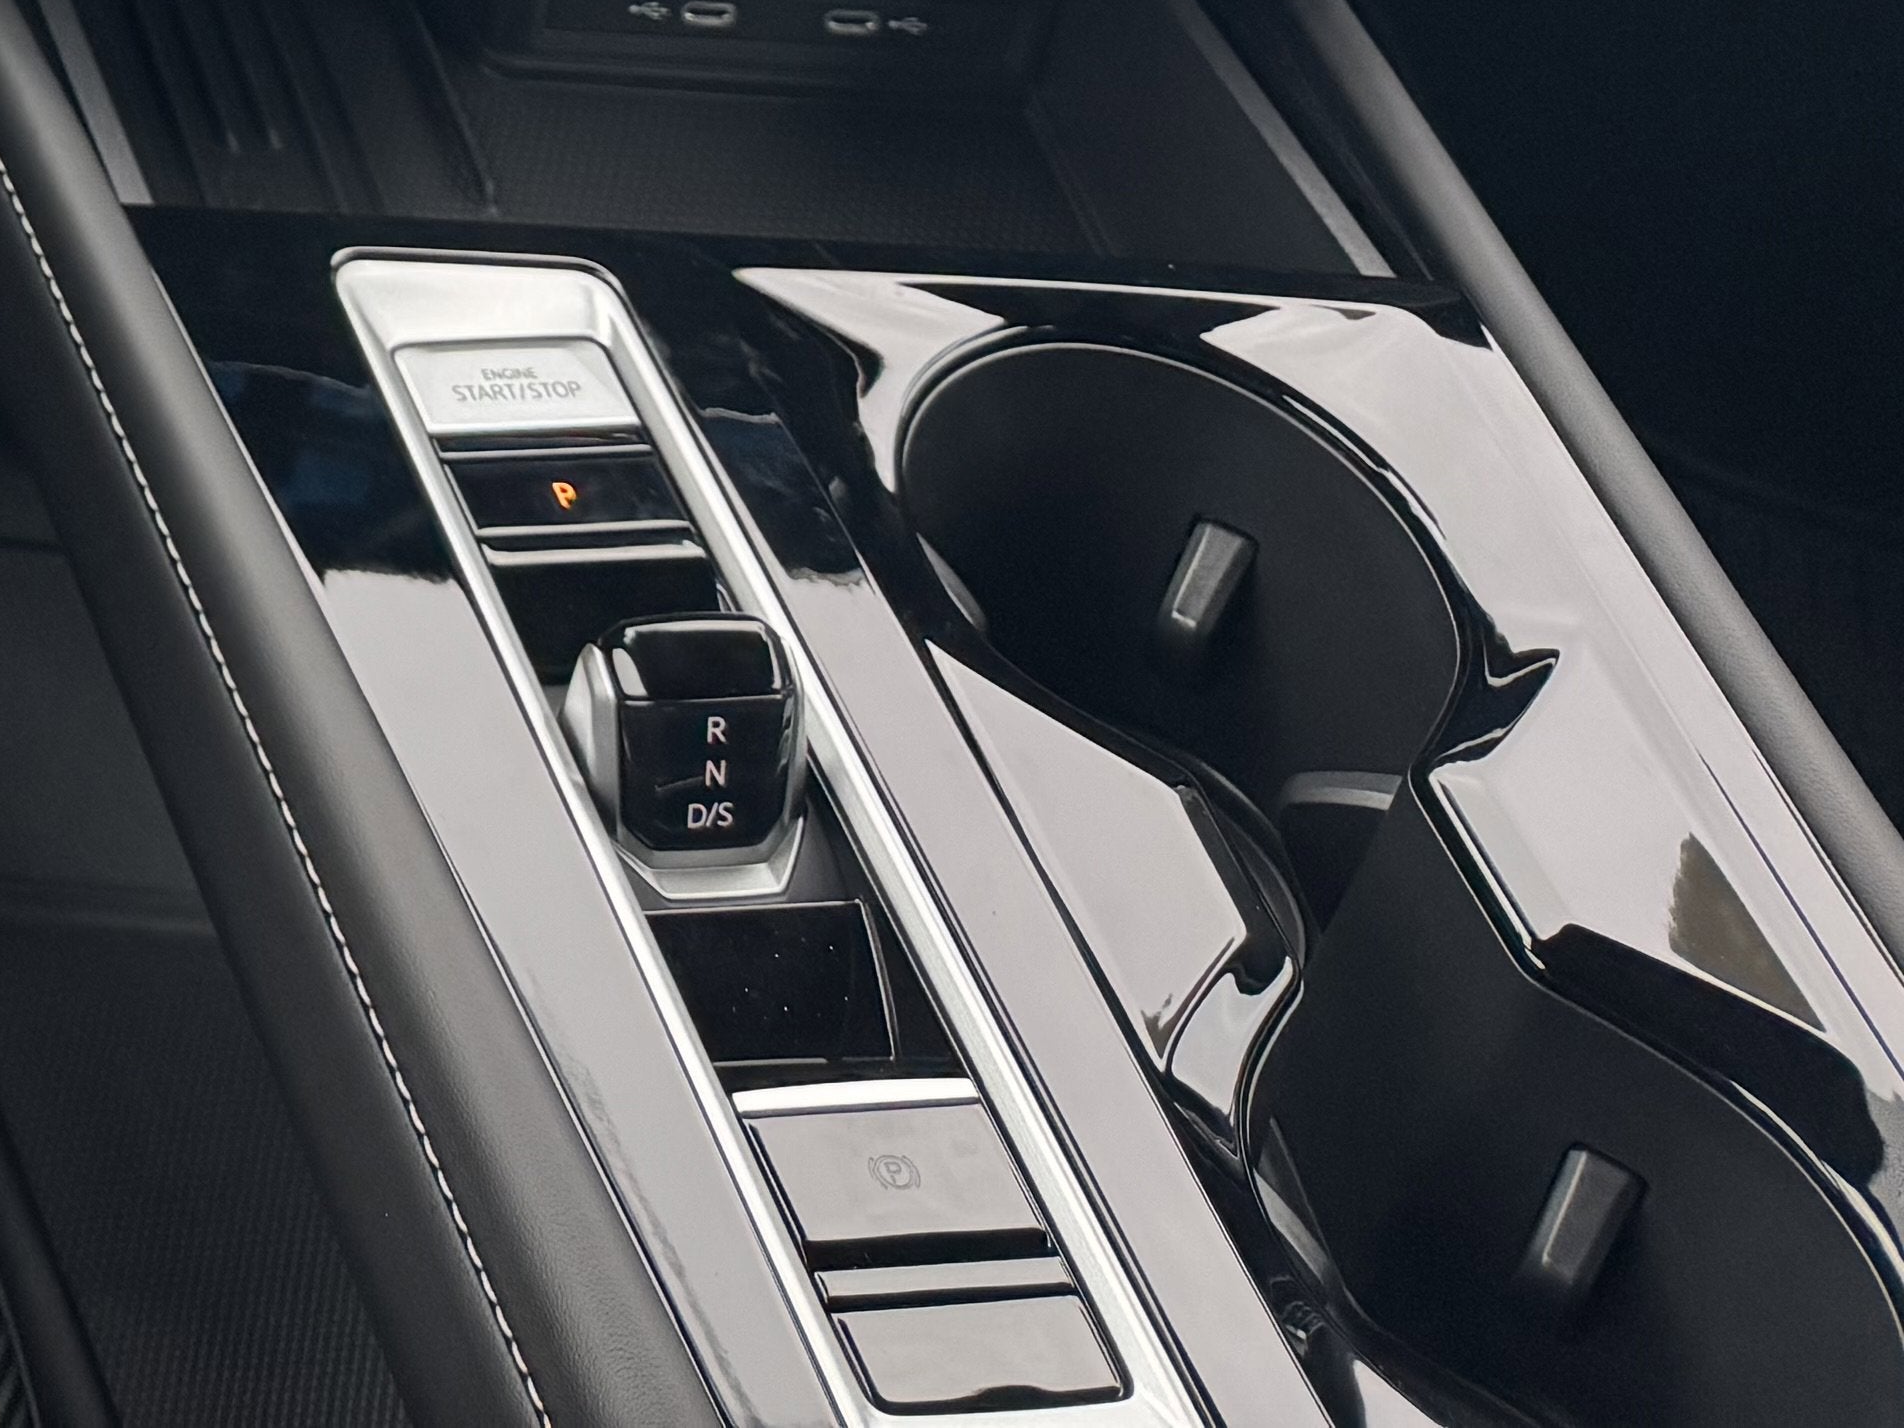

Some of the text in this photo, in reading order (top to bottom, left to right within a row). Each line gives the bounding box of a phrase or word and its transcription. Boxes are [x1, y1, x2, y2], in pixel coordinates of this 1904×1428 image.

[480, 366, 539, 382] ENGINE
[450, 380, 582, 403] START/STOP
[551, 481, 578, 511] P
[706, 716, 728, 745] R
[704, 759, 728, 788] N
[686, 801, 736, 830] D/S
